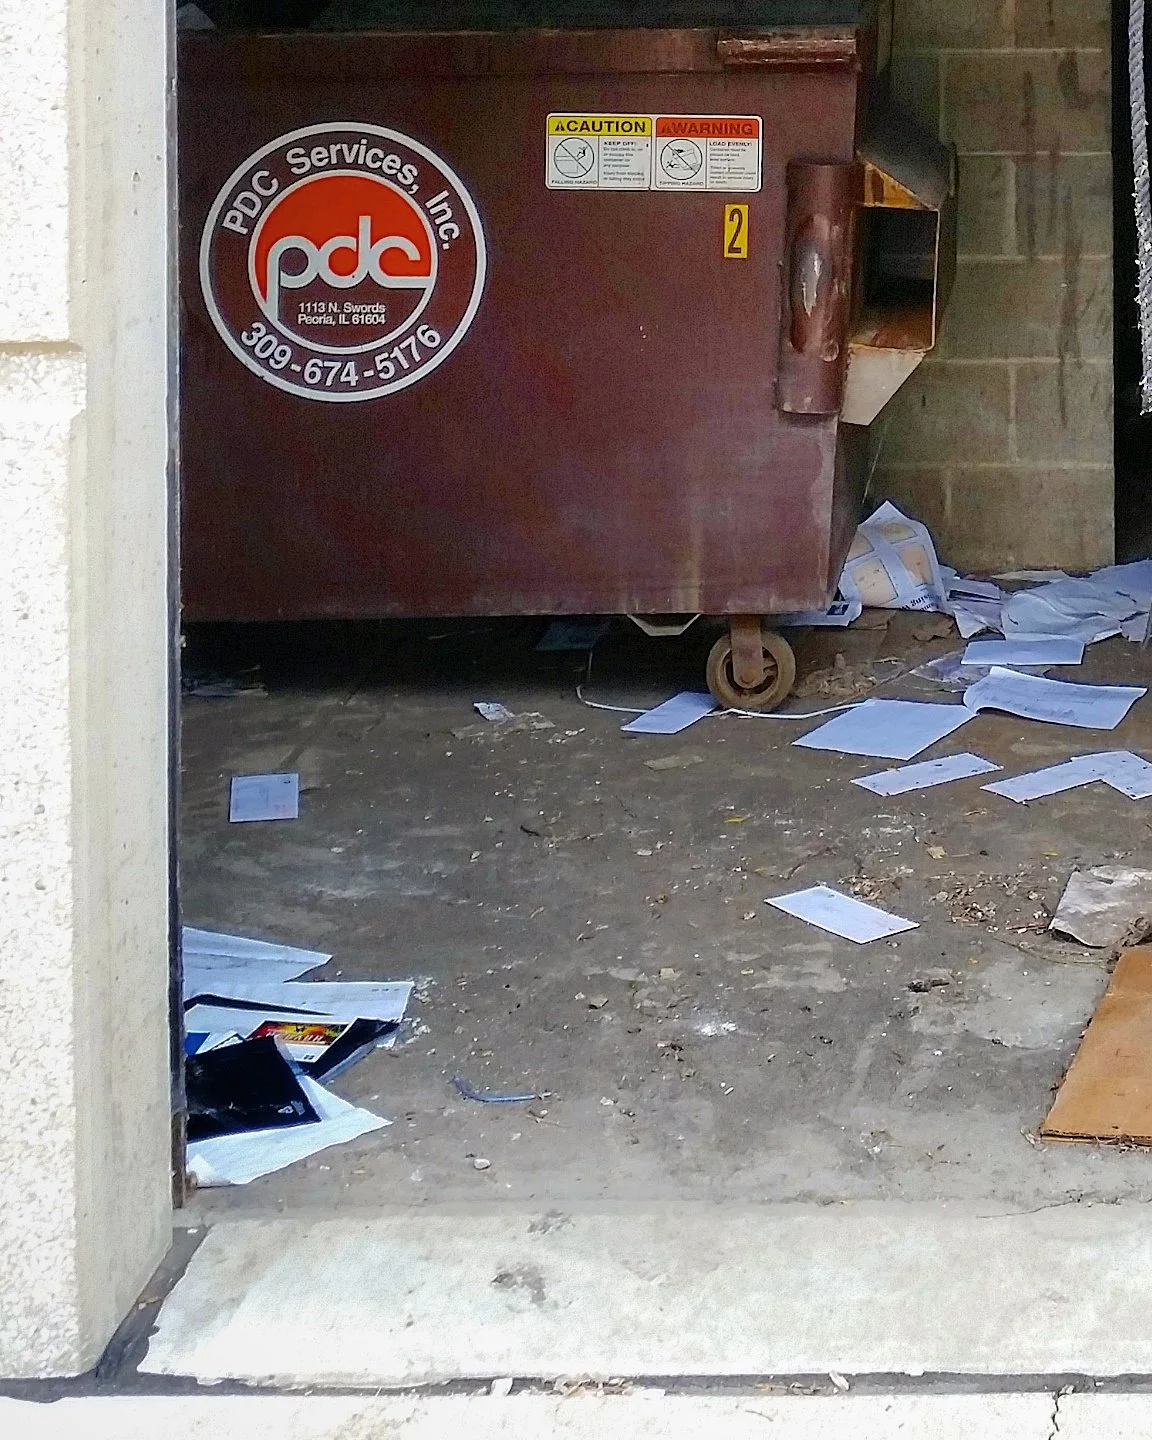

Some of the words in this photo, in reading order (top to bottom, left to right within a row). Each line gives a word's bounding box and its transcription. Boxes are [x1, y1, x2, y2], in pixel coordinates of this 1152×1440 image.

[566, 120, 646, 133] CAUTION
[672, 122, 754, 135] WARNING
[222, 170, 280, 235] PDC
[286, 138, 421, 194] Services,
[425, 190, 460, 251] Inc.
[728, 207, 743, 254] 2
[265, 215, 430, 322] pdc
[298, 302, 325, 314] 1113
[328, 302, 341, 314] N.
[343, 302, 386, 314] Swords
[298, 314, 336, 327] Peoria,
[338, 314, 350, 326] IL
[351, 314, 386, 326] 61604
[241, 322, 442, 387] 309-674-5176
